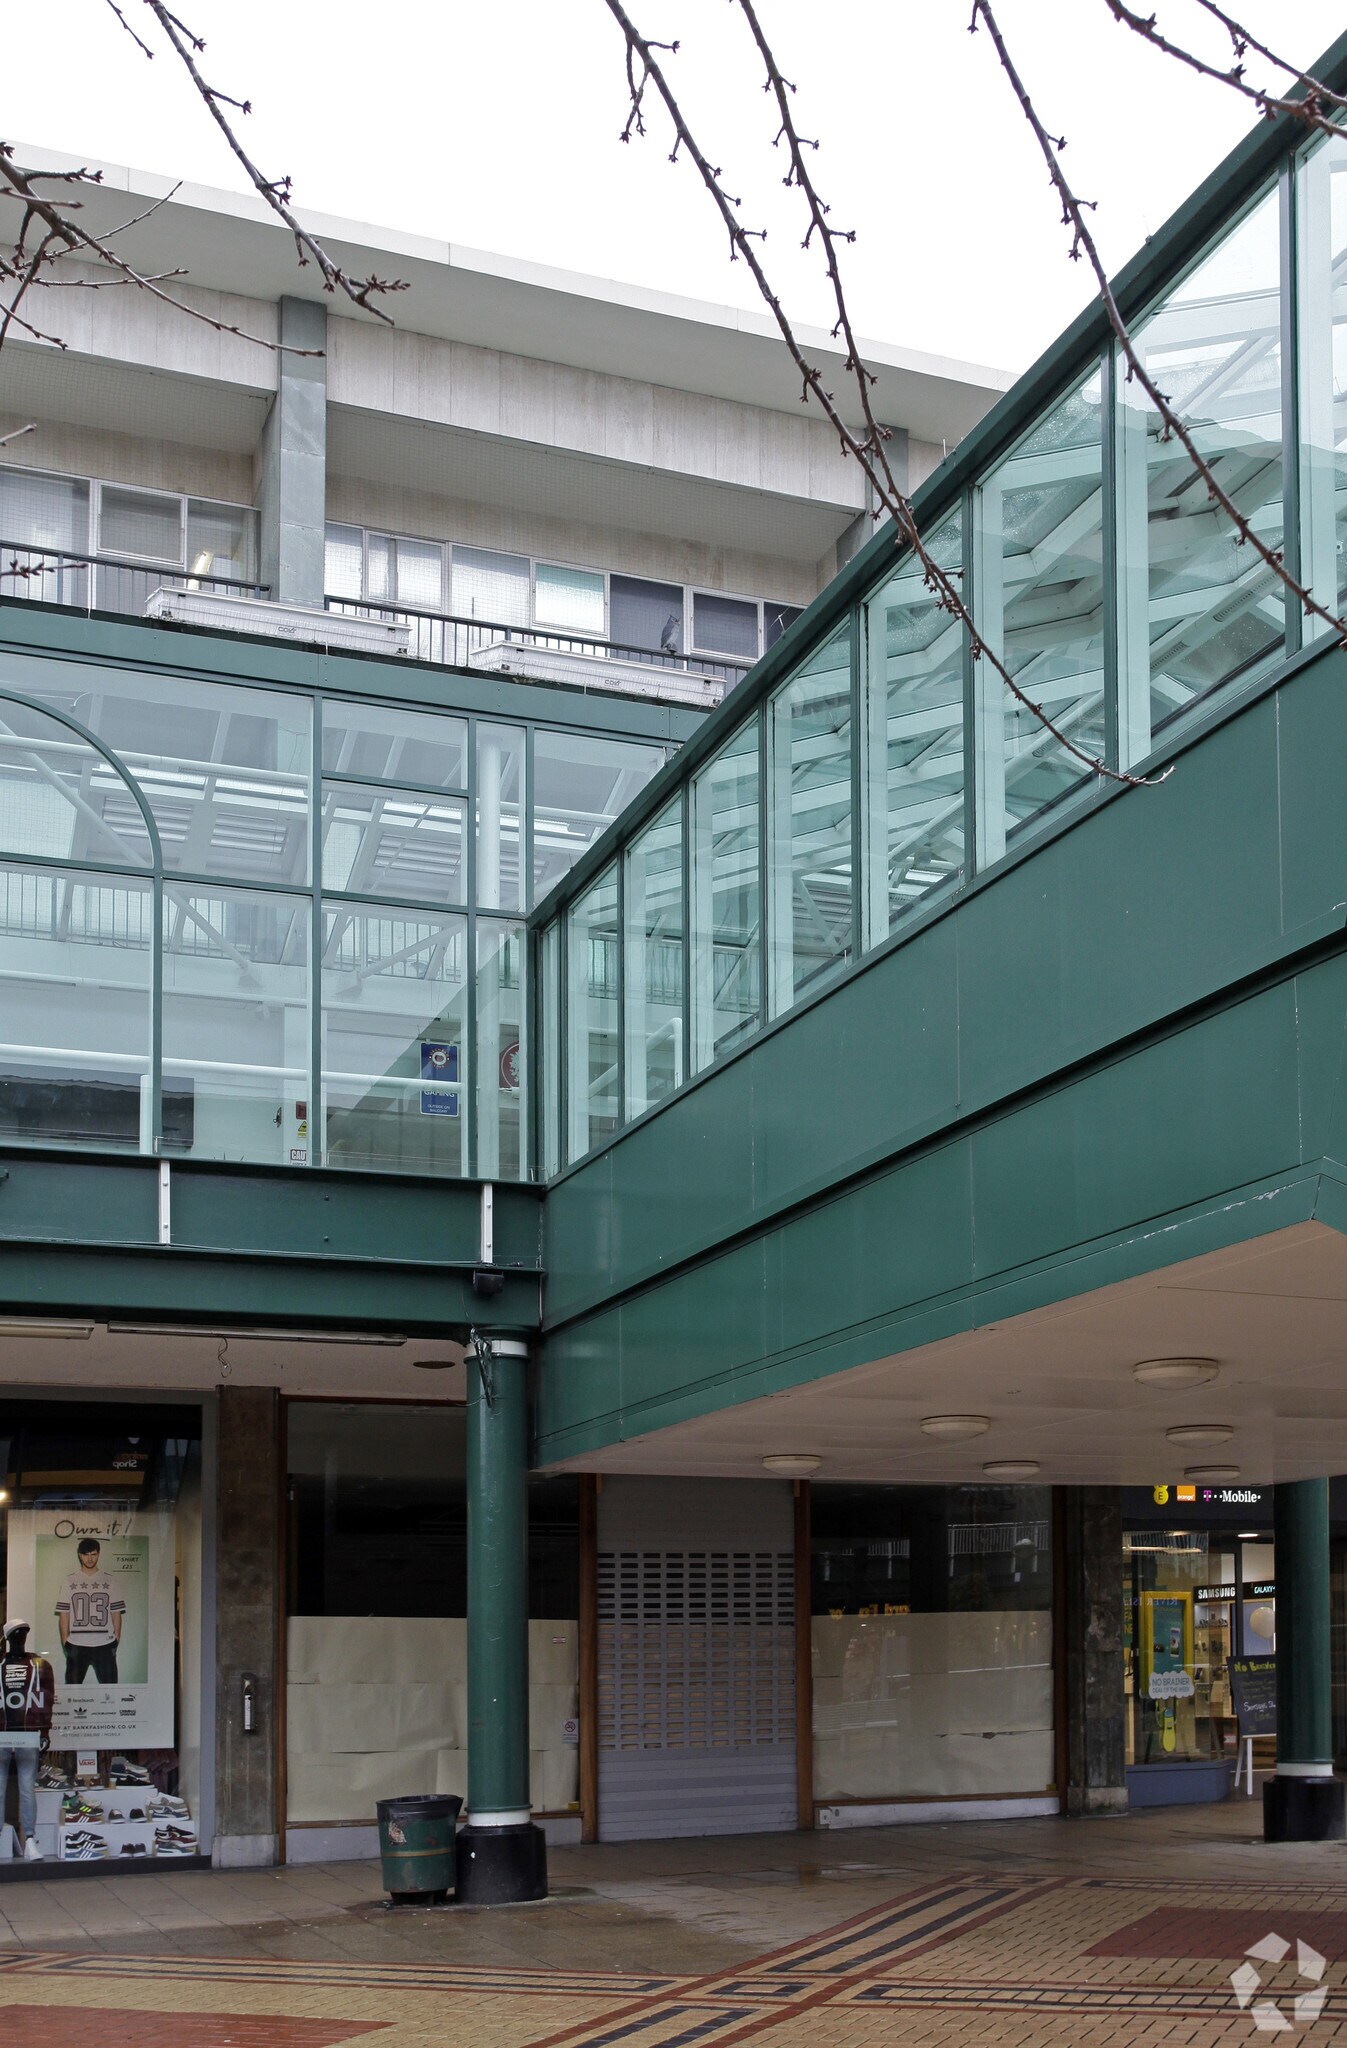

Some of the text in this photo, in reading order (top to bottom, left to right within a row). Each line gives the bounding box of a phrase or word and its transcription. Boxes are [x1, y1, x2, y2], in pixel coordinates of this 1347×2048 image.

[1198, 1586, 1236, 1600] SAMSUNG
[71, 1591, 110, 1627] 03
[1152, 1677, 1190, 1687] NO BRAINER
